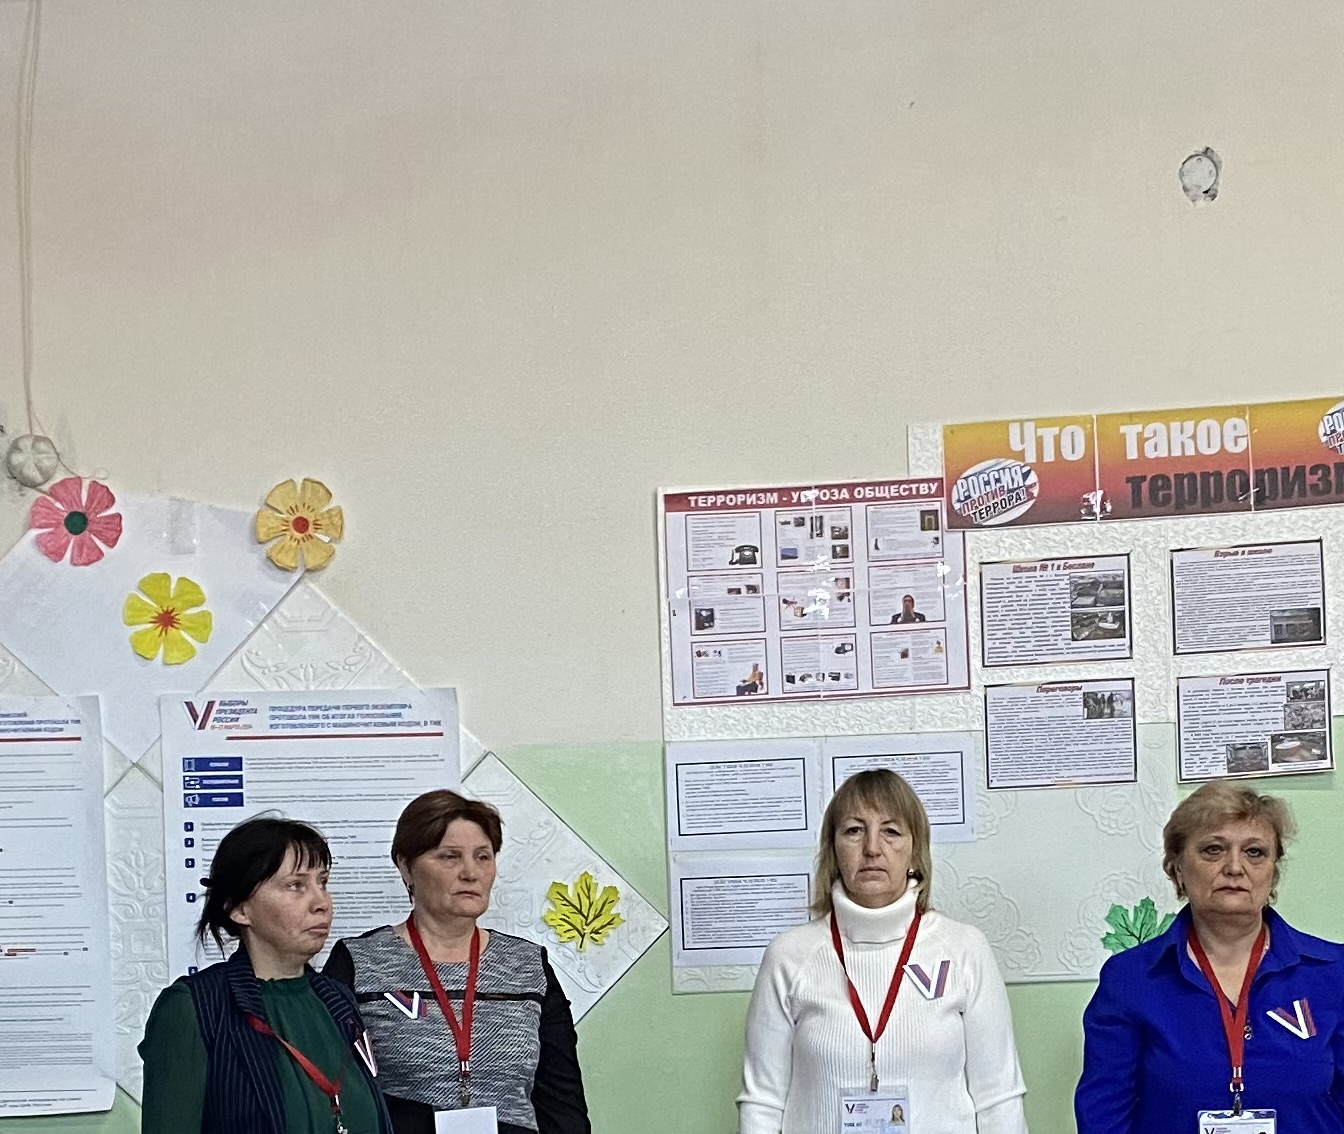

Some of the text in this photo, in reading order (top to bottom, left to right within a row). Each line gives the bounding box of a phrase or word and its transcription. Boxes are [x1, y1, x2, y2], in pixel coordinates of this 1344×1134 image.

[1008, 417, 1249, 462] Что такое
[688, 492, 778, 508] ТЕРРОРИЗМ
[853, 482, 938, 500] ОБЩЕСТВУ
[956, 465, 1024, 501] РОССИЯ
[962, 485, 1006, 516] ПРОТИВ
[972, 487, 1026, 521] ТЕРРОРА!
[1219, 677, 1245, 685] После
